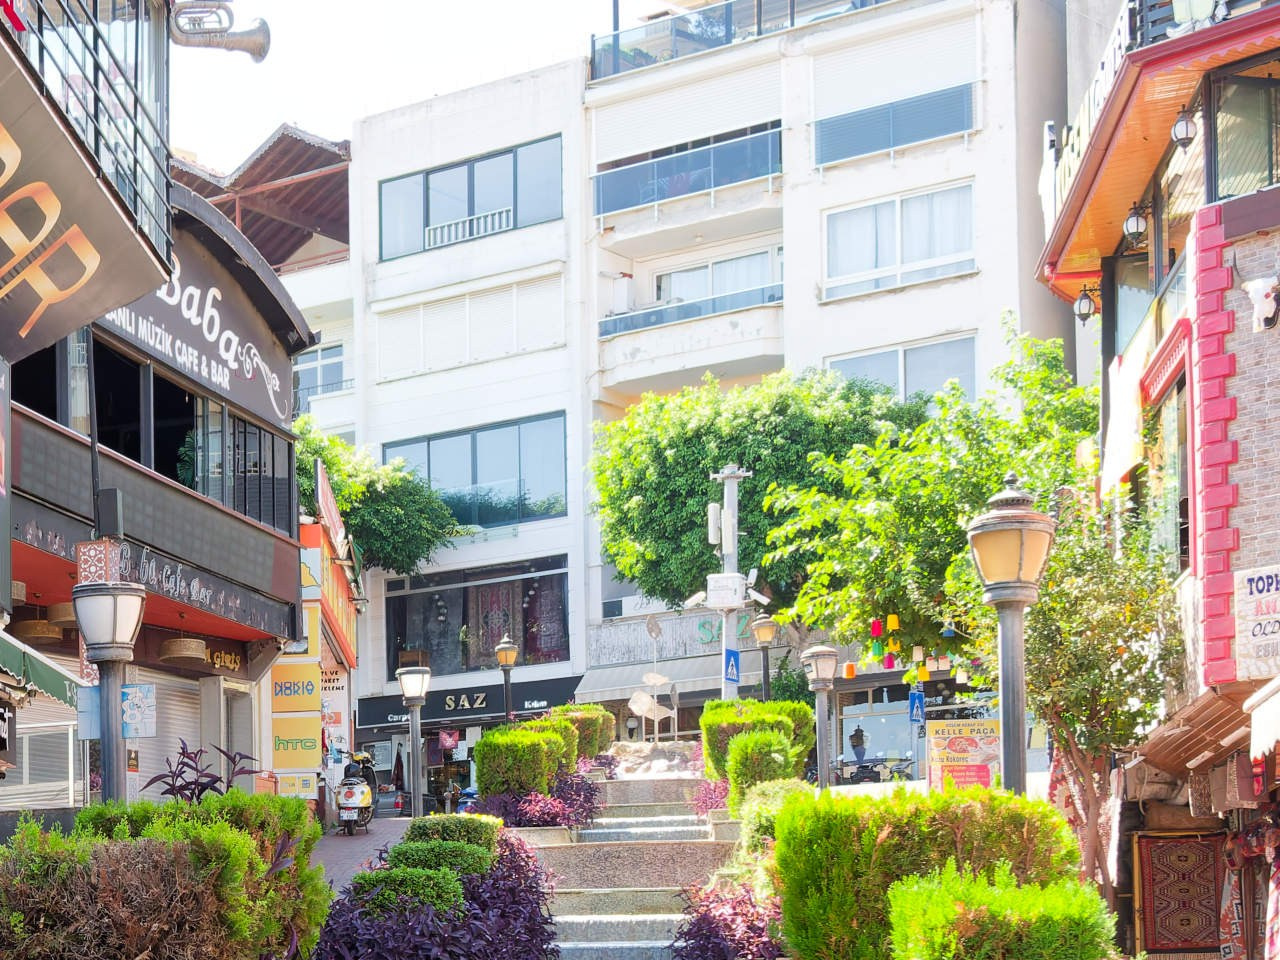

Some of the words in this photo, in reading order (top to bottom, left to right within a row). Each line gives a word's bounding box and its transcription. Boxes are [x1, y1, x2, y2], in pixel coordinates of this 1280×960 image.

[137, 316, 174, 357] MÜZİK
[175, 340, 199, 372] CAFE
[200, 355, 209, 379] &
[211, 359, 230, 391] BAR
[445, 692, 487, 710] SAZ
[934, 728, 964, 736] KELLE
